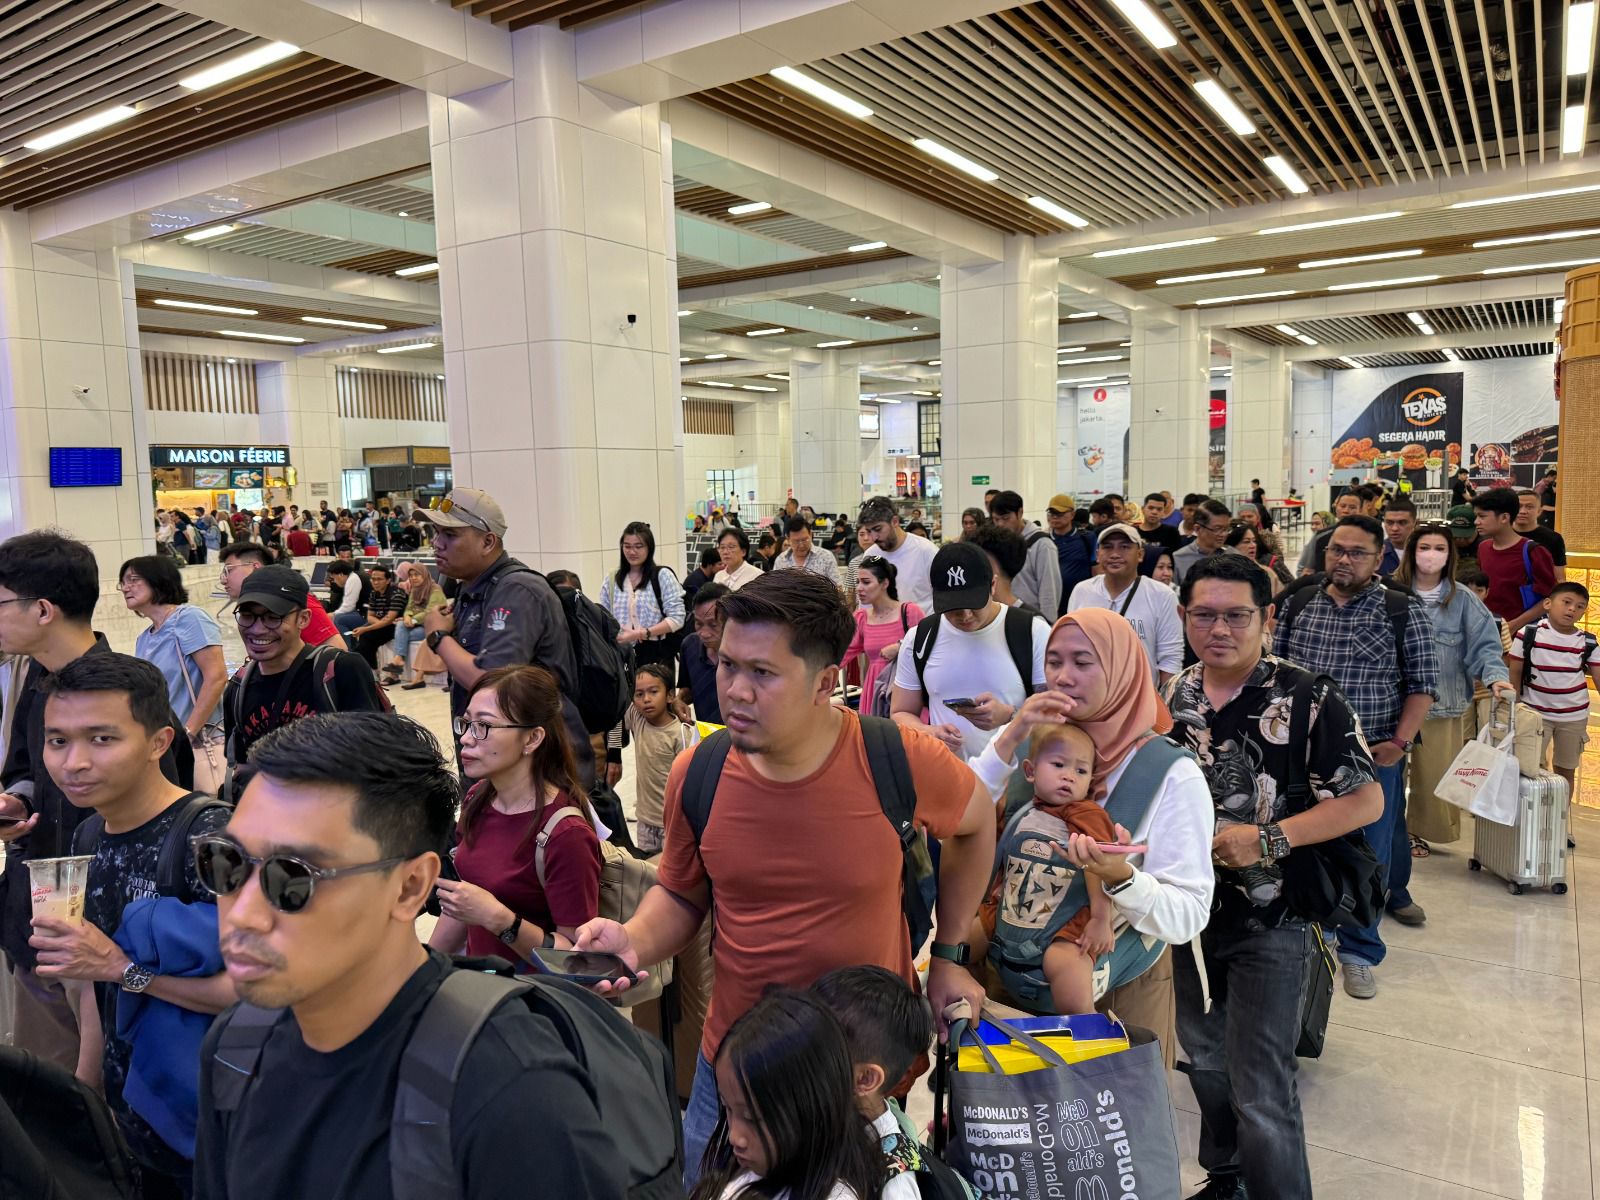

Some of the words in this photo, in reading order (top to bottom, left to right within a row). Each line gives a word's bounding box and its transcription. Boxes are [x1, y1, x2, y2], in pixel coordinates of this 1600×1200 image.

[1401, 396, 1446, 418] TEXAS
[1378, 431, 1414, 443] SEGERA
[1415, 430, 1446, 442] HADIR
[169, 449, 235, 463] MAISON
[239, 446, 285, 464] FÉERIE
[963, 1105, 1029, 1120] McDONALD'S
[1056, 1099, 1089, 1123] McD
[967, 1127, 1030, 1139] McDonald's
[1060, 1119, 1100, 1152] on
[1033, 1103, 1065, 1200] McDonald
[1096, 1089, 1139, 1200] onald's
[970, 1151, 1015, 1170] McD
[973, 1169, 1019, 1192] on
